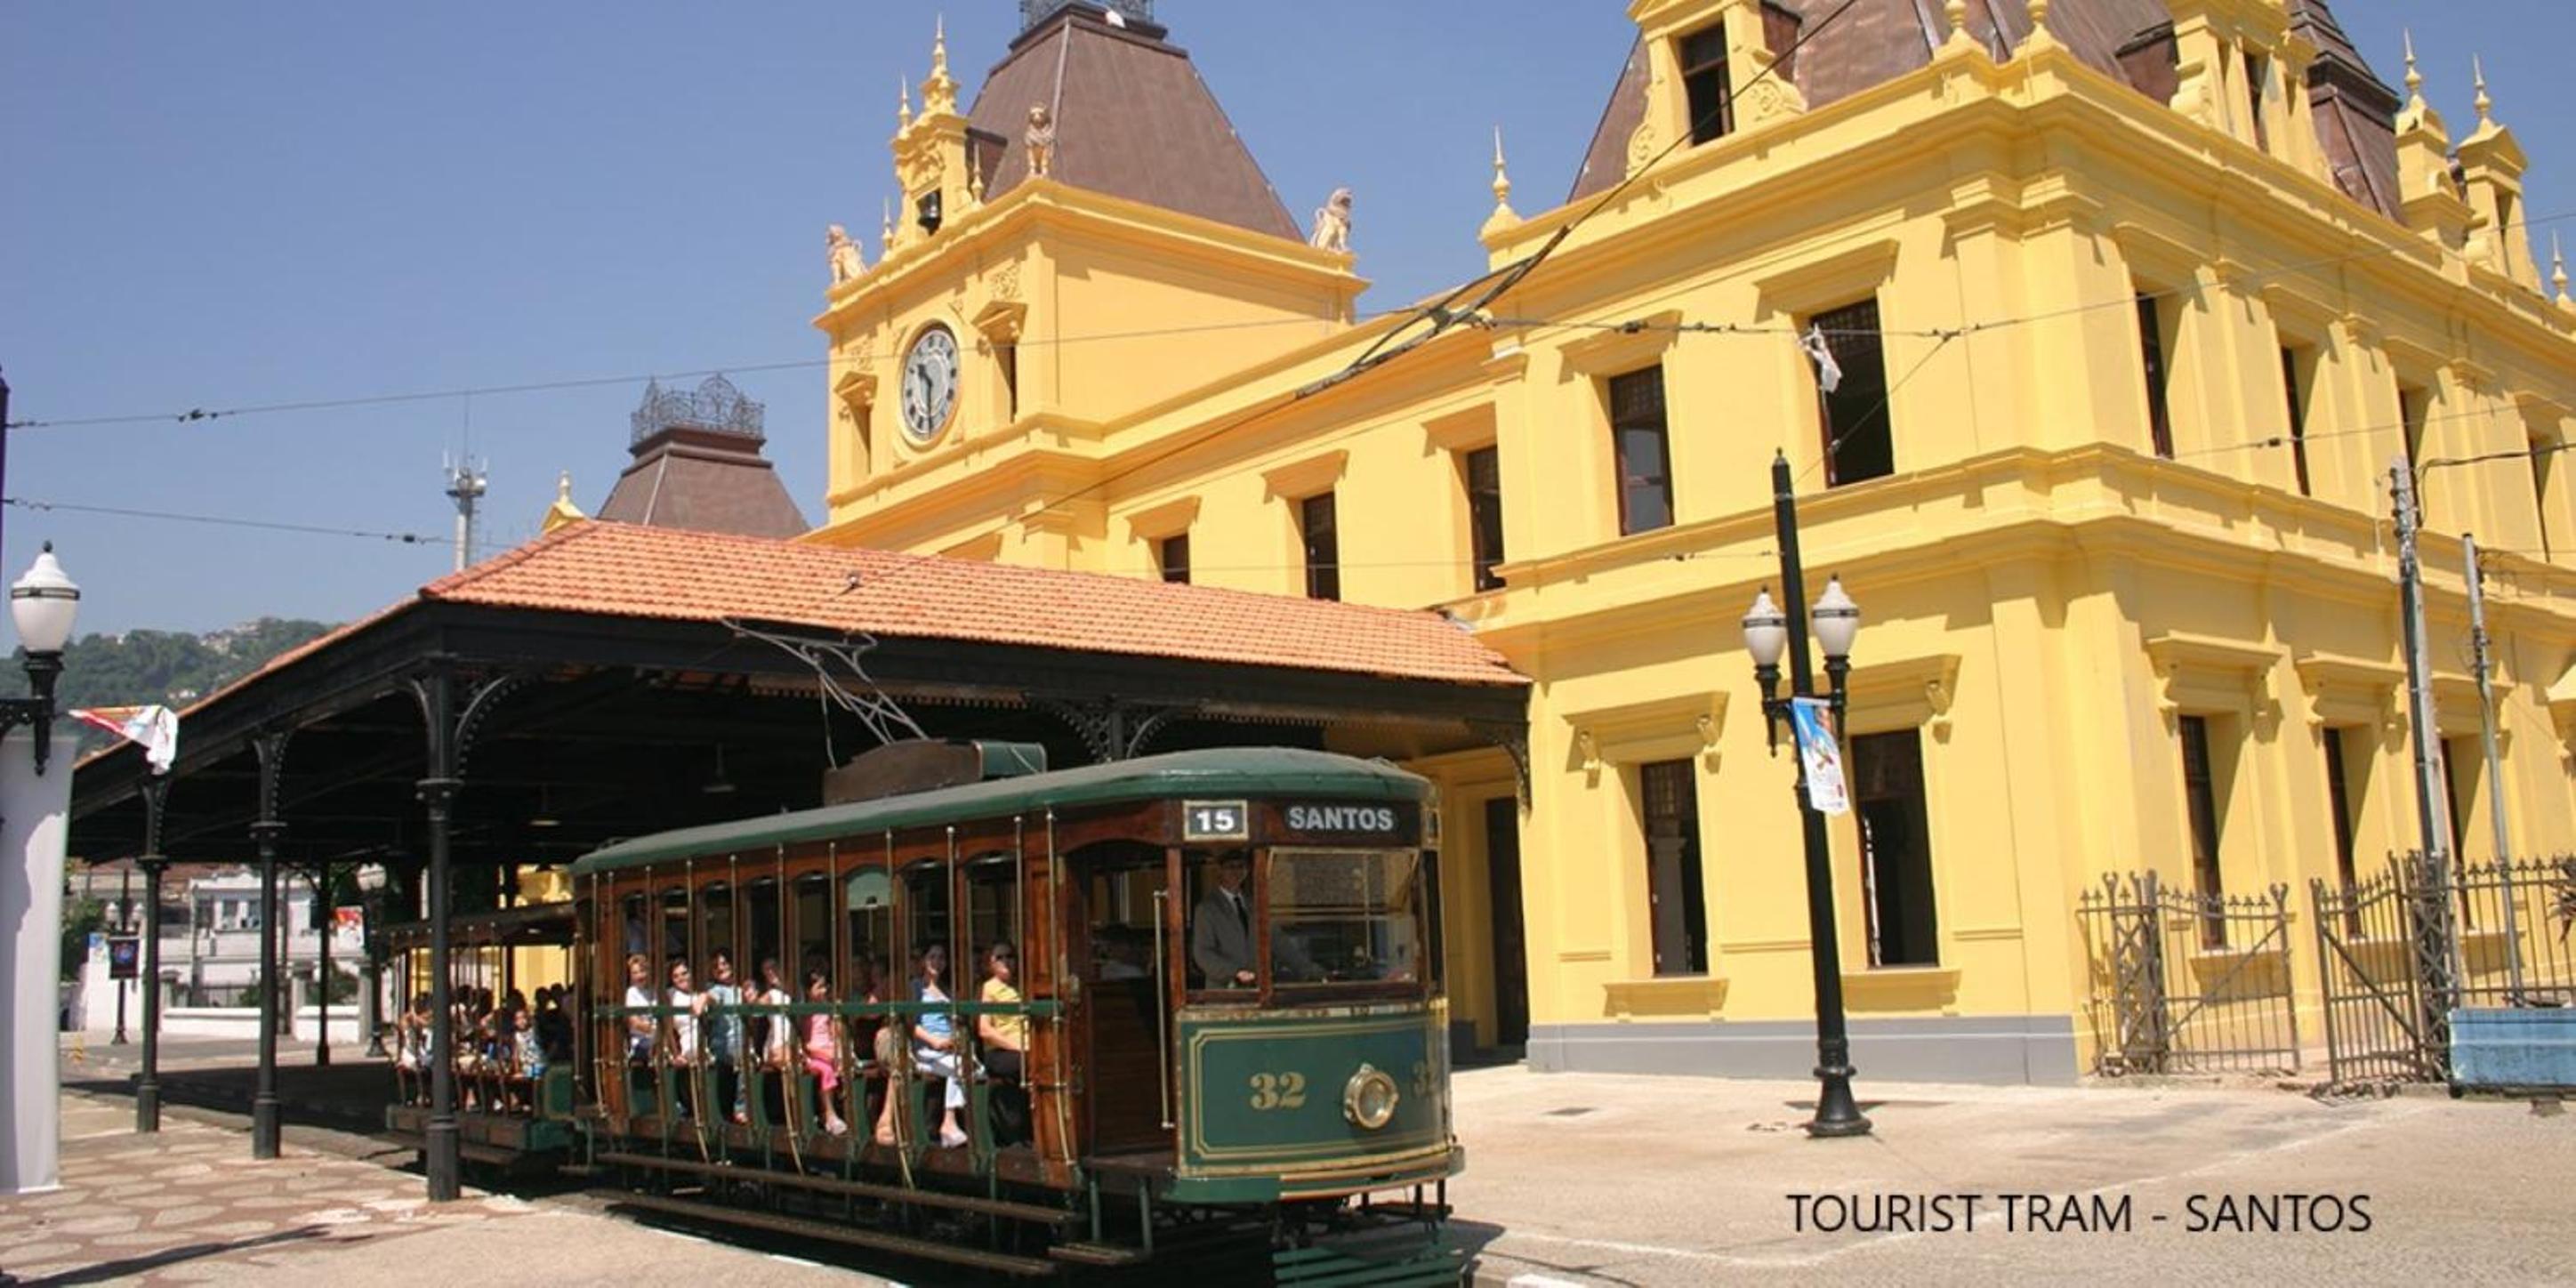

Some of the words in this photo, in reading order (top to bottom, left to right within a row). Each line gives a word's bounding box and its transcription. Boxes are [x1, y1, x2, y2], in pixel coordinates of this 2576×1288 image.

[1195, 809, 1236, 833] 15
[1288, 807, 1393, 831] SANTOS
[1249, 1071, 1307, 1110] 32
